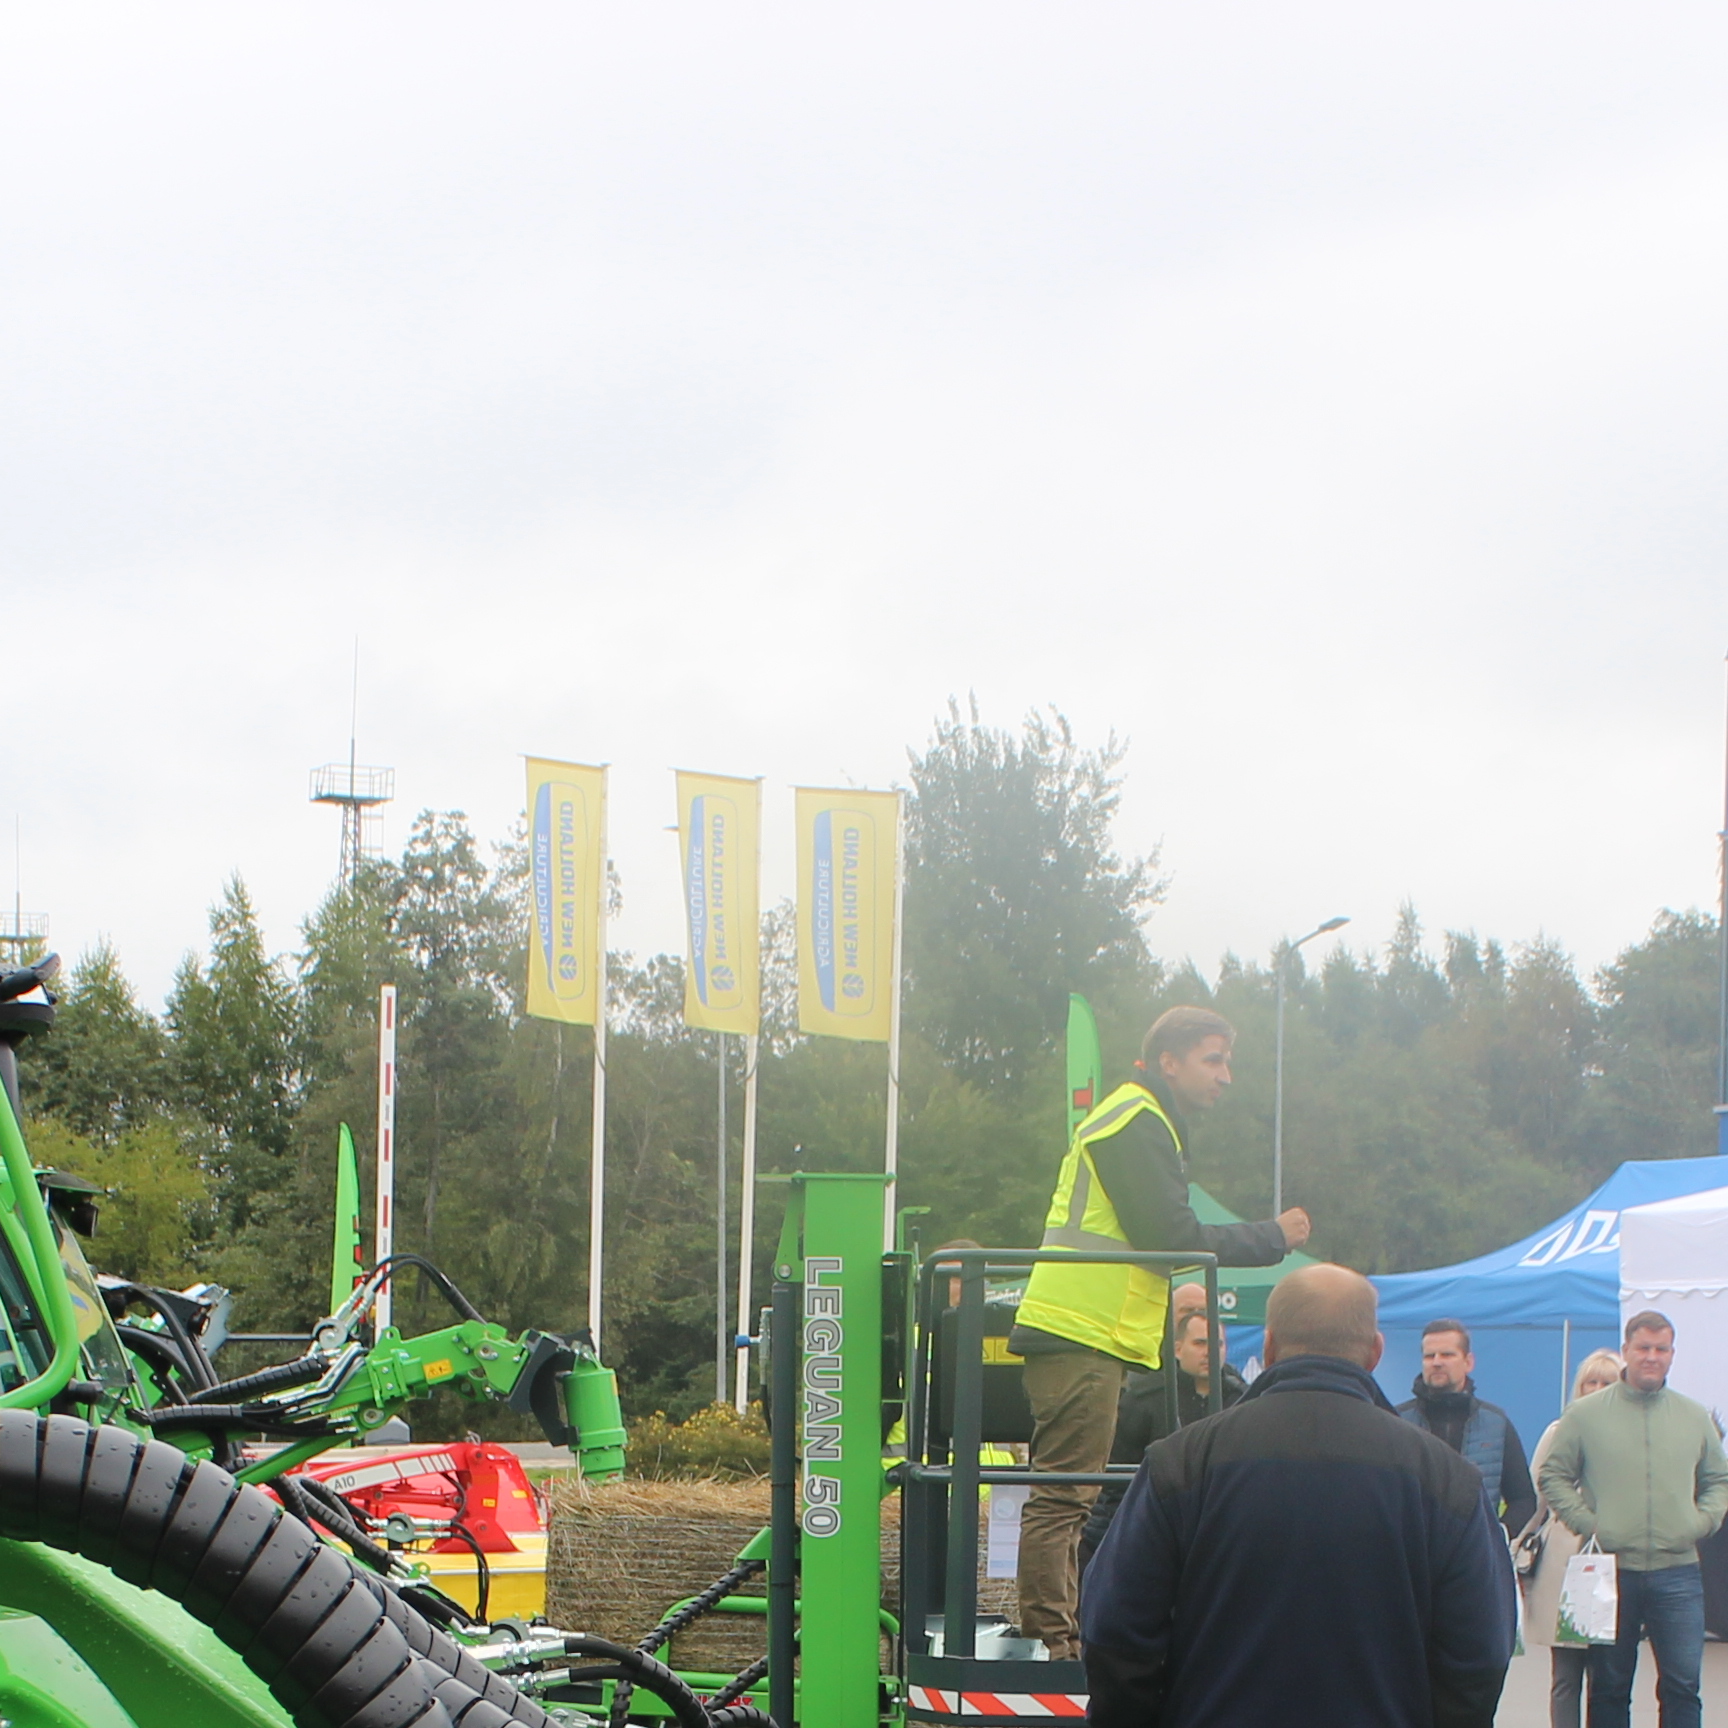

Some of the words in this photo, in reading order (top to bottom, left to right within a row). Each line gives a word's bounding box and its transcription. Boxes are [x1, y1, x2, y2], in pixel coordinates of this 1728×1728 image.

[803, 1256, 843, 1462] LEGUAN
[334, 1474, 356, 1490] A10
[802, 1474, 842, 1538] 50
